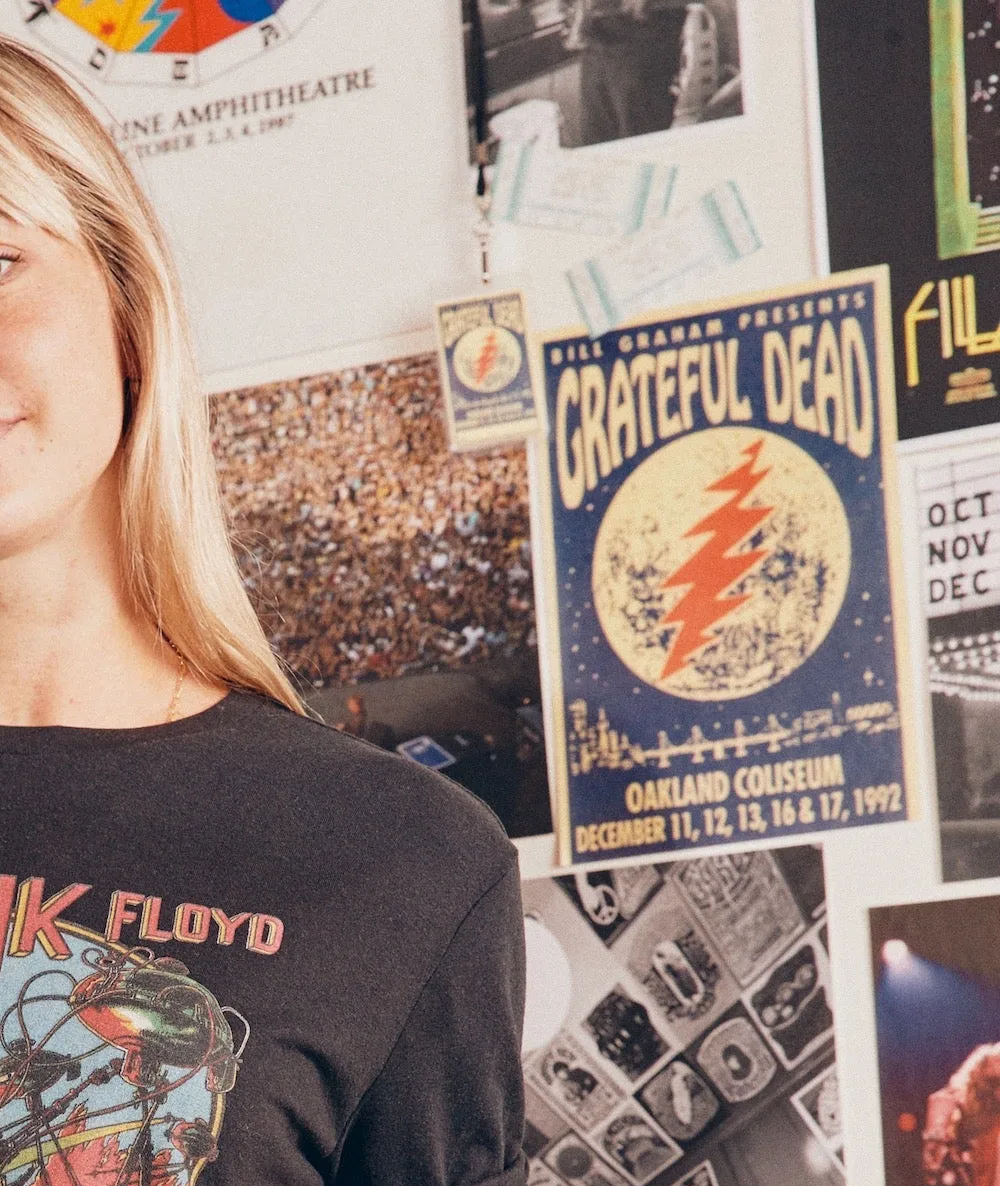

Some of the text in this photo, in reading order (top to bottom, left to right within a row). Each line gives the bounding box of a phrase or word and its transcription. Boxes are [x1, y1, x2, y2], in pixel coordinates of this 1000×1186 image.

[172, 67, 375, 130] AMPHITHEATRE
[550, 292, 866, 365] BILL GRAHAM PRESENTS
[556, 316, 874, 510] GRATEFUL DEAD
[928, 491, 992, 527] OCT
[928, 530, 990, 565] NOV
[928, 570, 989, 603] DEC
[625, 754, 845, 814] OAKLAND COLISEUM
[575, 783, 901, 853] DECEMBER 11, 12, 13, 16 & 17, 1992
[105, 889, 285, 955] FLOYD
